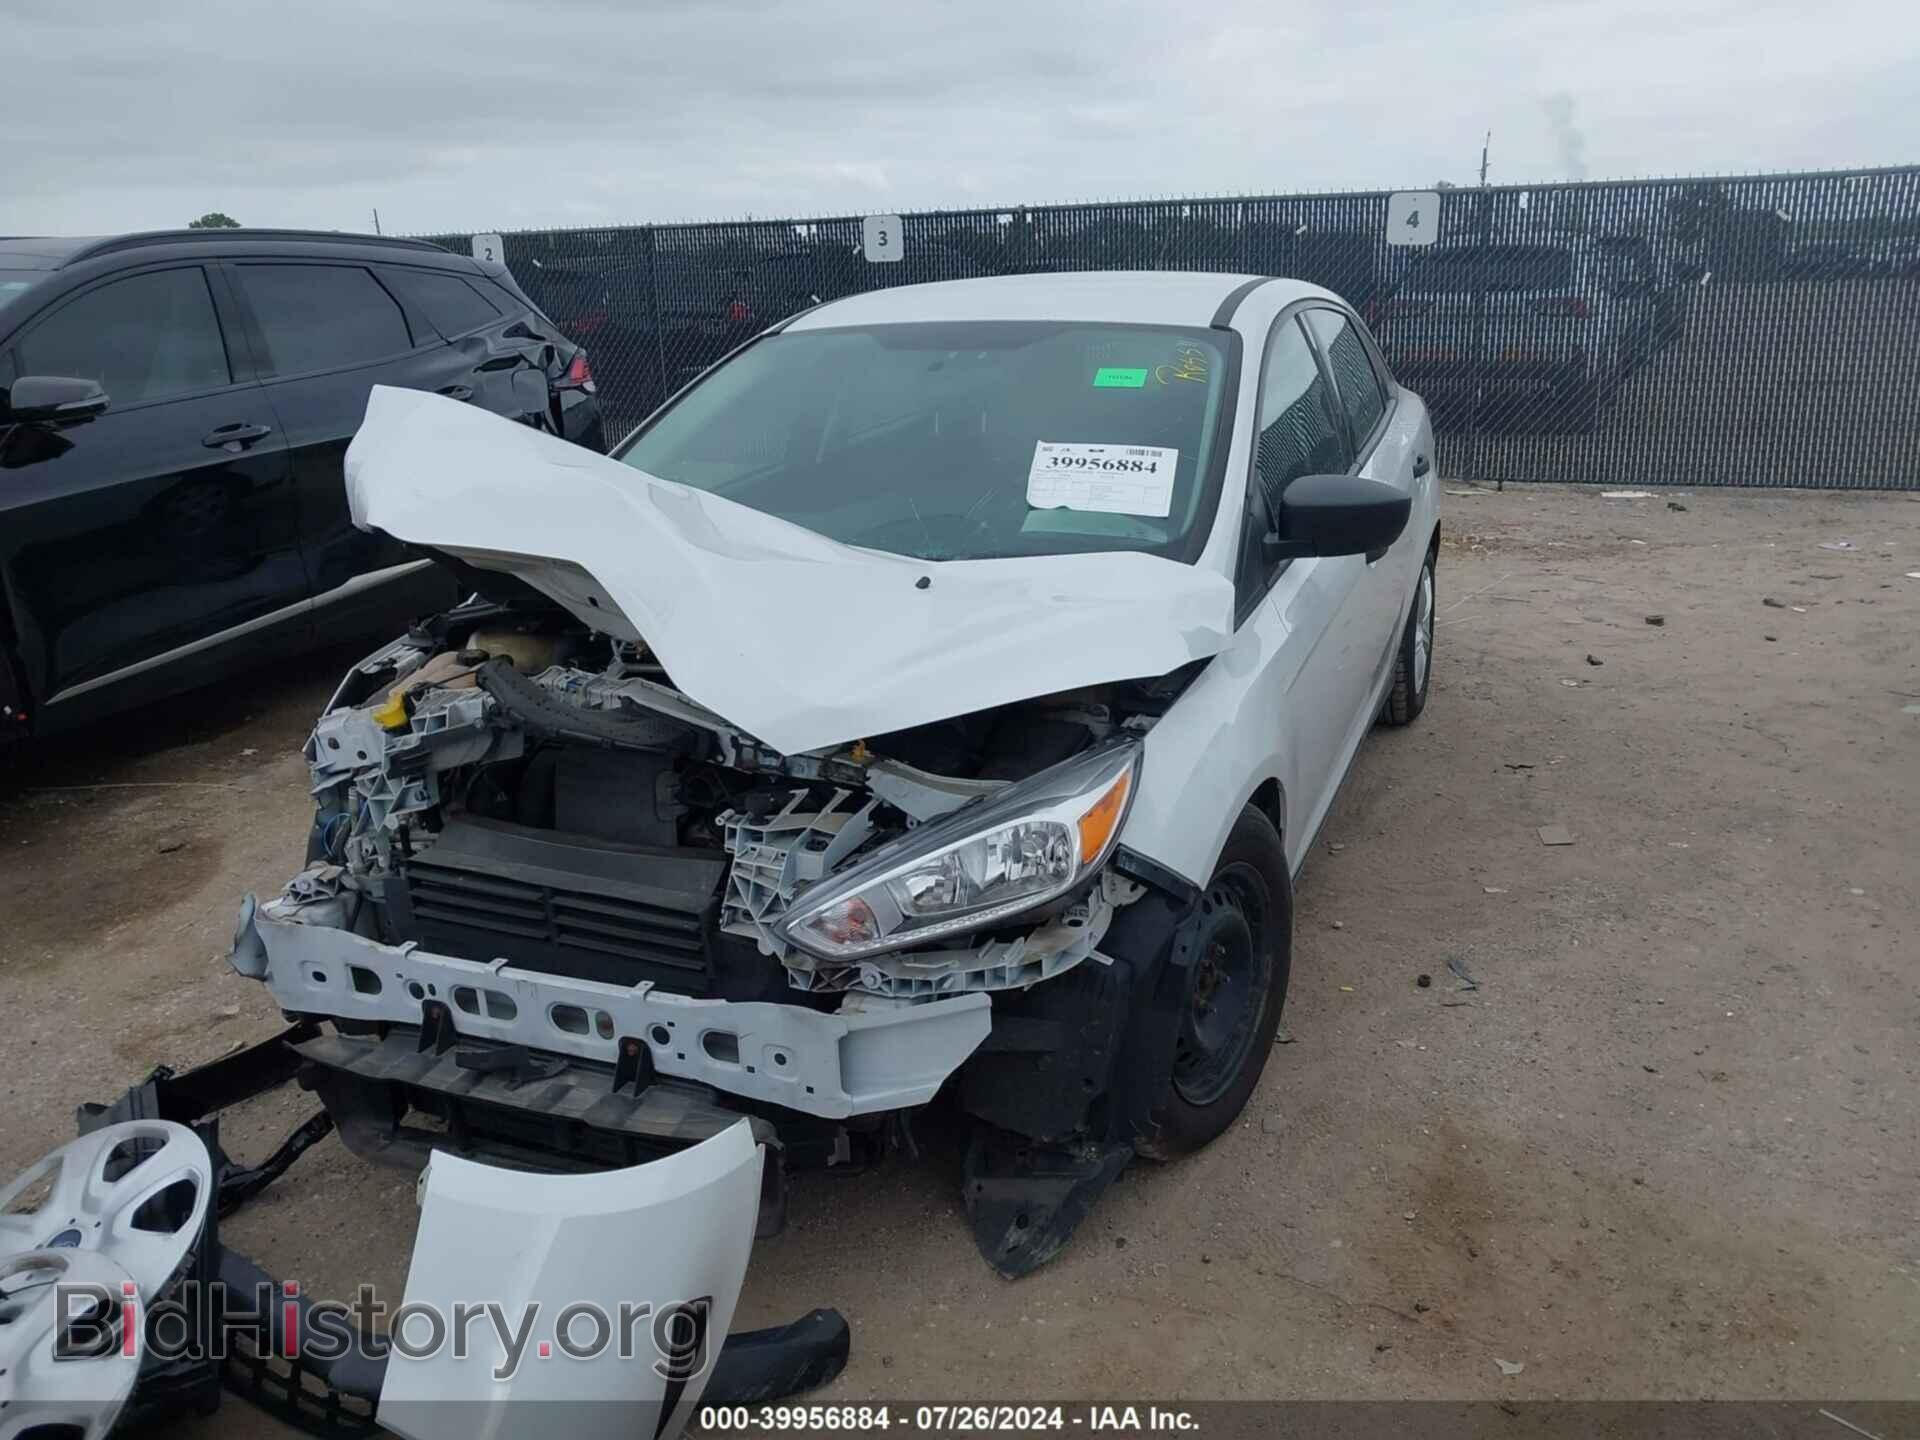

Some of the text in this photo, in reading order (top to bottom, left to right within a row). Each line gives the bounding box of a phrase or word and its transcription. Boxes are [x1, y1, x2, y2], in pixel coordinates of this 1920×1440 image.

[1405, 209, 1421, 229] 4
[877, 230, 888, 247] 3
[484, 247, 494, 261] 2
[1045, 456, 1158, 474] 39956884
